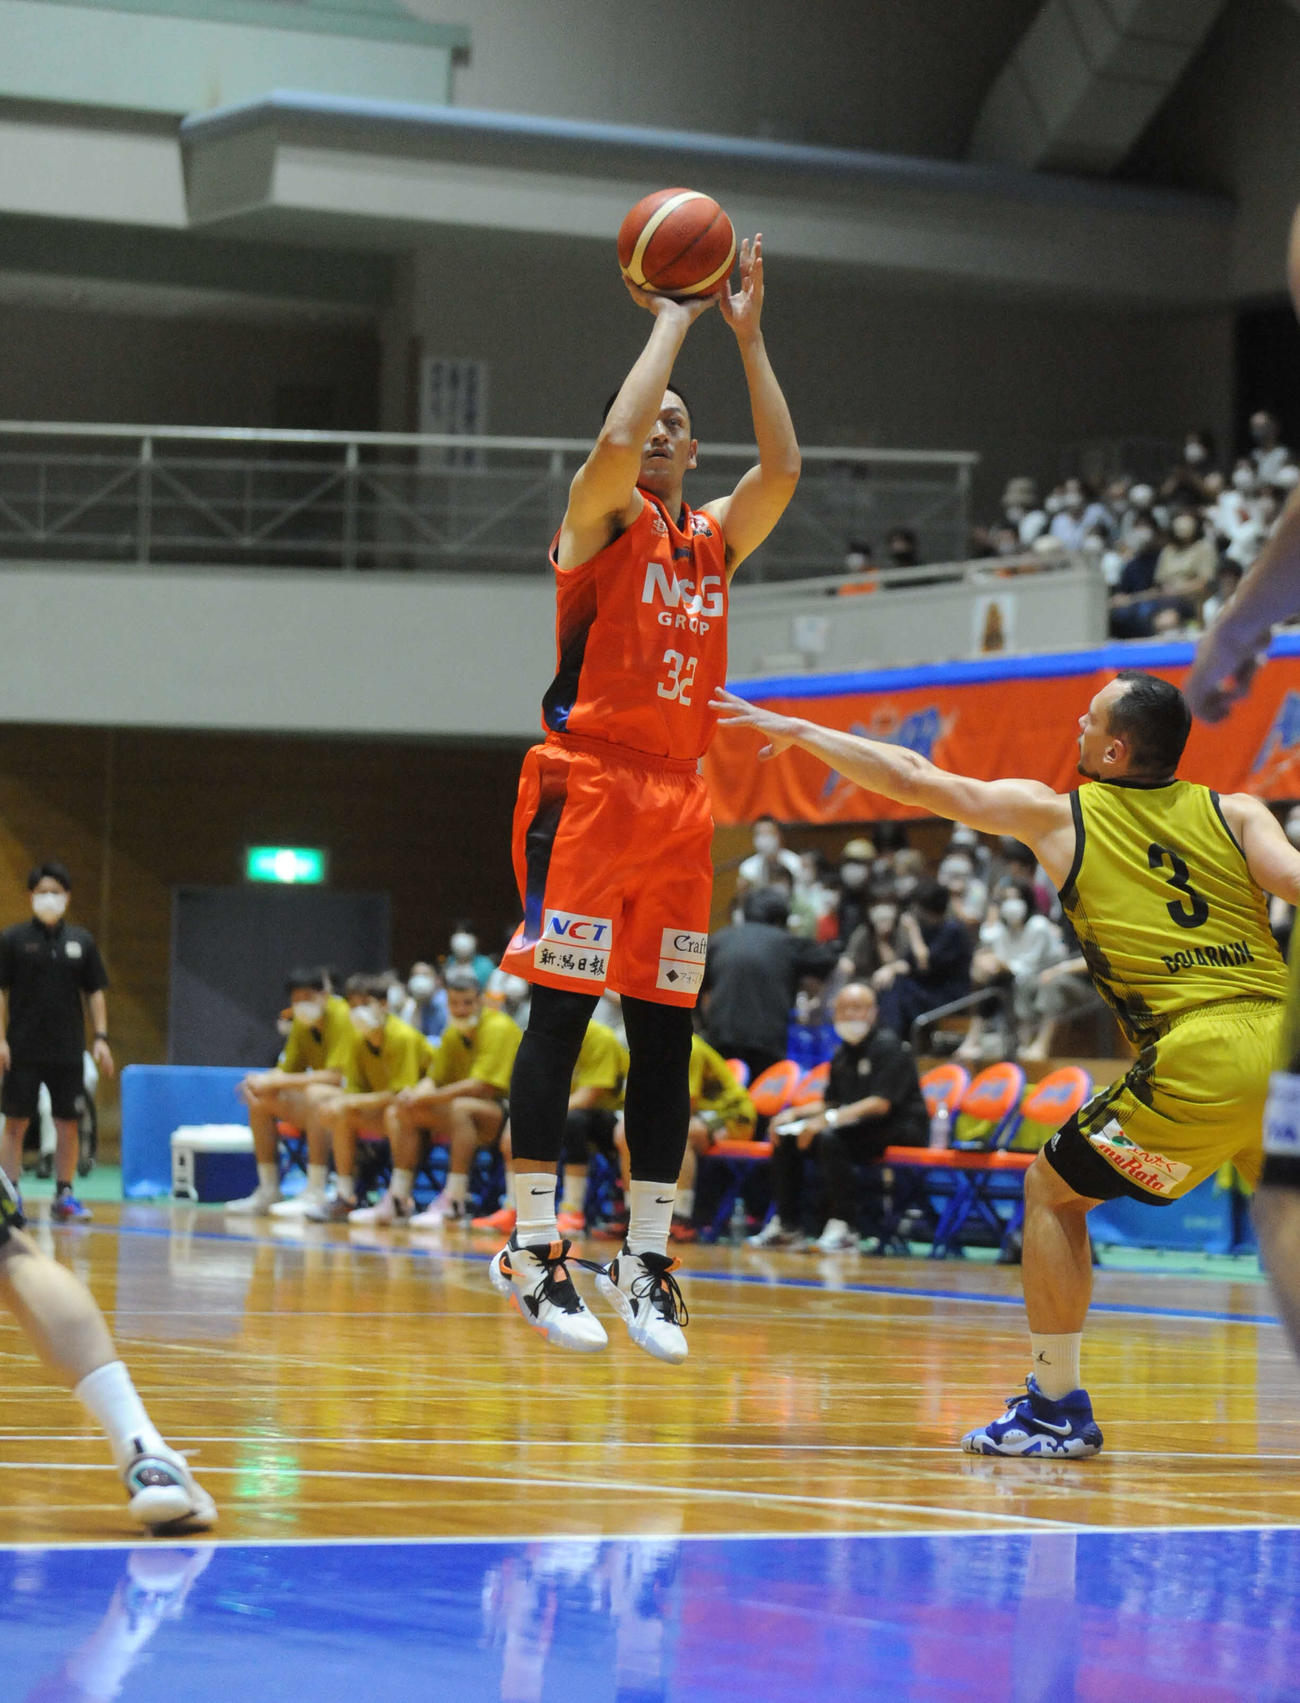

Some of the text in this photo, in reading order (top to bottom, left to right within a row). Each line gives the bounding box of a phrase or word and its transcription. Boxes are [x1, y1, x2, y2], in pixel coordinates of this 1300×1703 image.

[656, 649, 698, 707] 32
[1147, 842, 1209, 929] 3
[551, 917, 608, 942] NCT
[539, 948, 605, 976] 新潟日報
